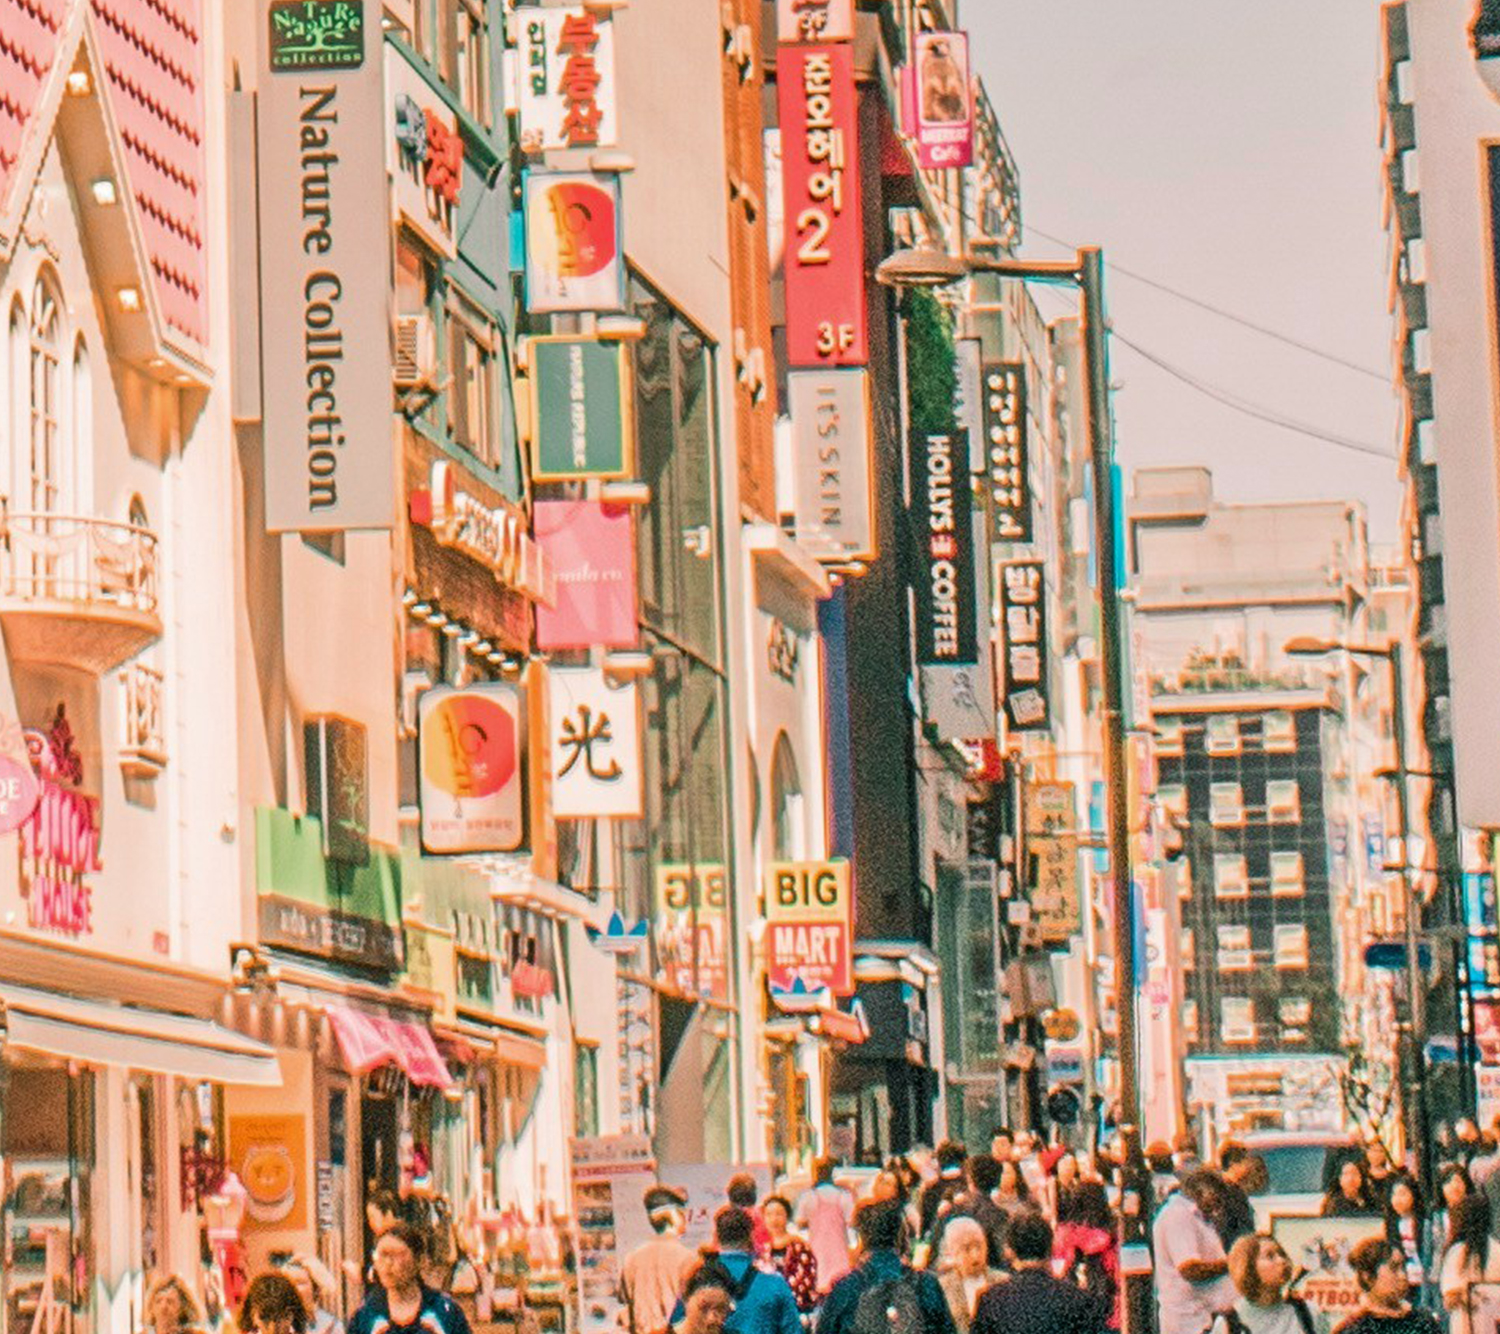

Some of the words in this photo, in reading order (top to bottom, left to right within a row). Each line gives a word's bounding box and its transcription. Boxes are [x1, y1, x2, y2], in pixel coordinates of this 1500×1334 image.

[556, 13, 604, 148] 부동산
[299, 83, 341, 256] Nature
[797, 209, 831, 266] 2
[816, 321, 855, 358] 3F
[302, 270, 343, 514] Collection
[926, 434, 956, 533] HOLLYS
[930, 560, 959, 658] COFFEE
[557, 704, 623, 784] 光
[777, 870, 839, 908] BIG
[773, 926, 840, 966] MART
